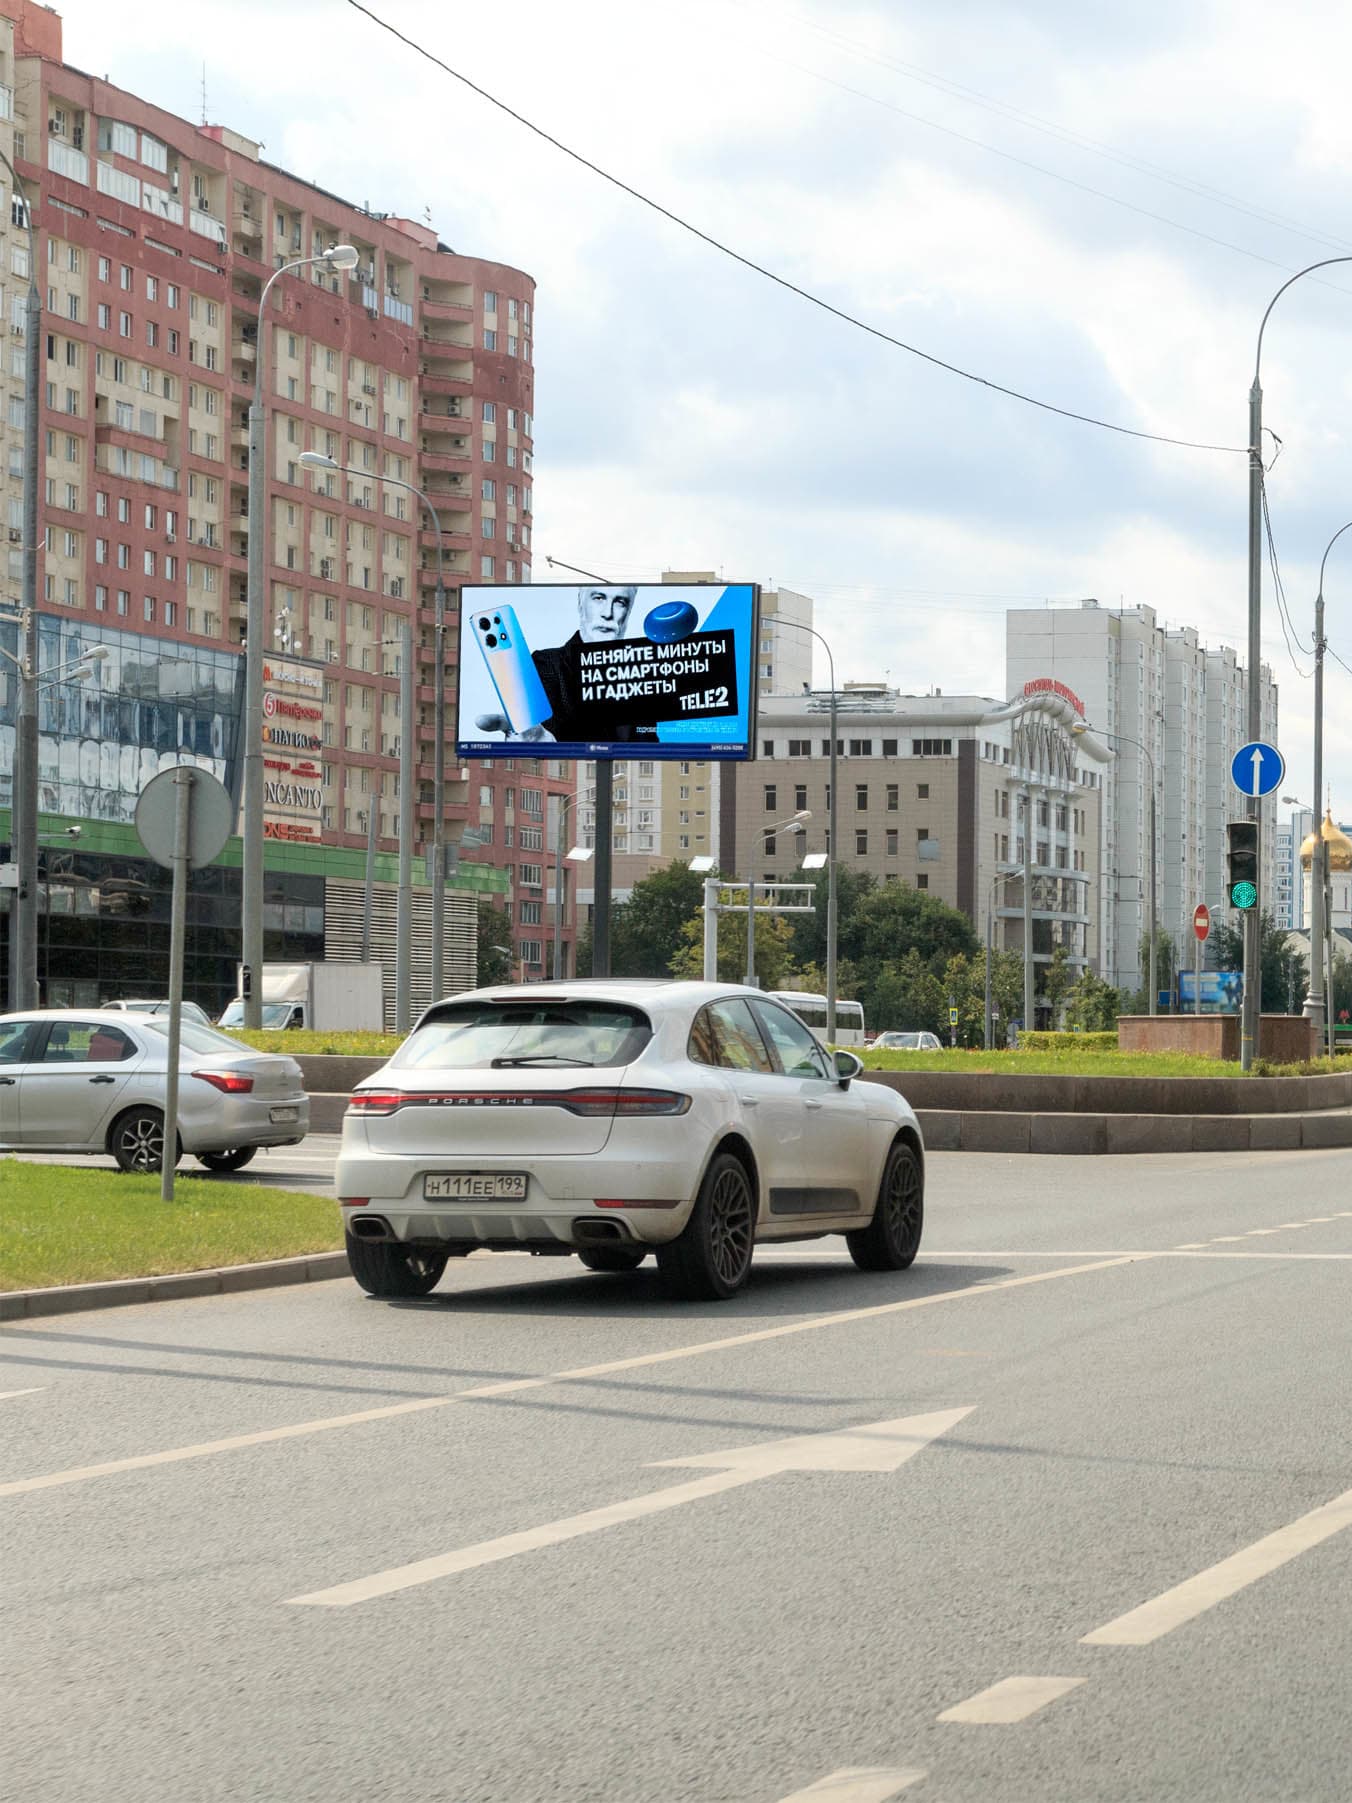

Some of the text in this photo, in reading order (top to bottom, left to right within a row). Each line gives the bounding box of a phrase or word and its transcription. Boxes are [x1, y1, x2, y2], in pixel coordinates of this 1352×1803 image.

[580, 639, 726, 666] МЕНЯЙТЕ МИНУТЫ
[581, 658, 709, 683] НА СМАРТФОНЫ
[581, 679, 676, 701] И ГАДЖЕТЫ
[679, 686, 729, 710] TELE2
[264, 782, 323, 809] NCANTO
[431, 1177, 522, 1195] Н111ЕЕ 199
